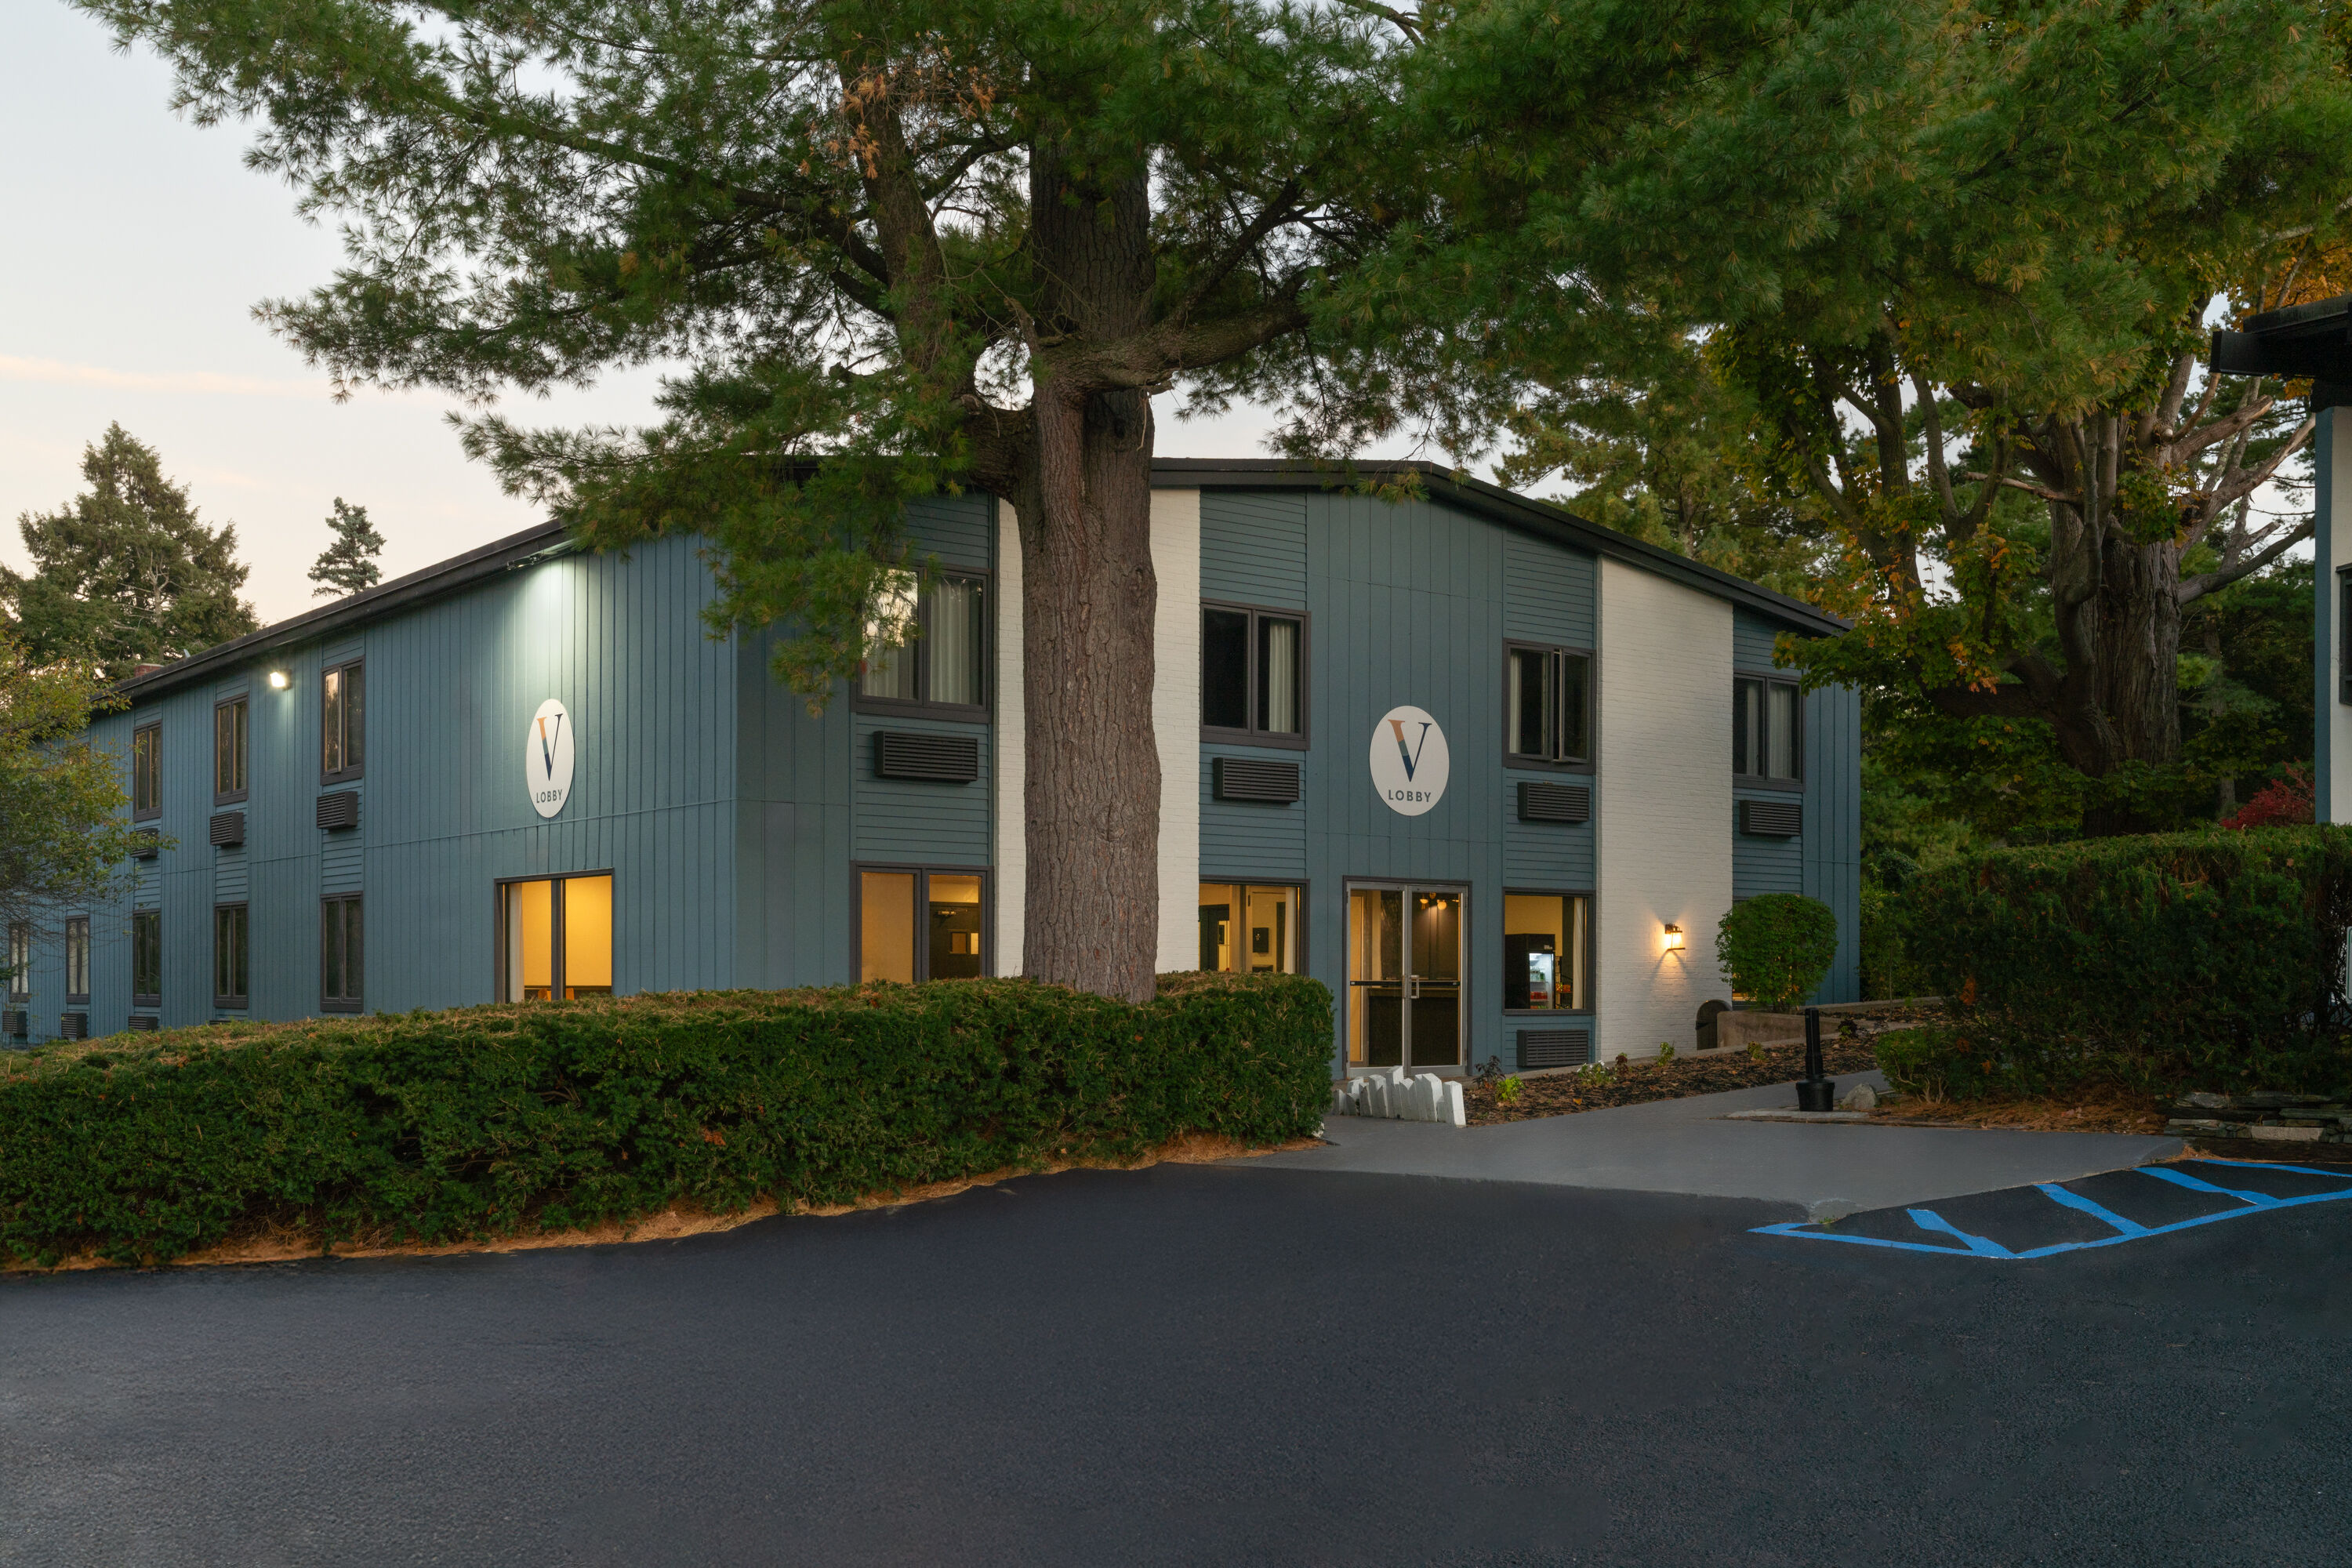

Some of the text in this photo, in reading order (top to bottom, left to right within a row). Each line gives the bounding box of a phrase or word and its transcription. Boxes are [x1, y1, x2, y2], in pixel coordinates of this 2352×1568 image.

[536, 713, 564, 782] V
[1388, 719, 1432, 782] V
[536, 789, 563, 804] LOBBY
[1388, 789, 1432, 803] LOBBY
